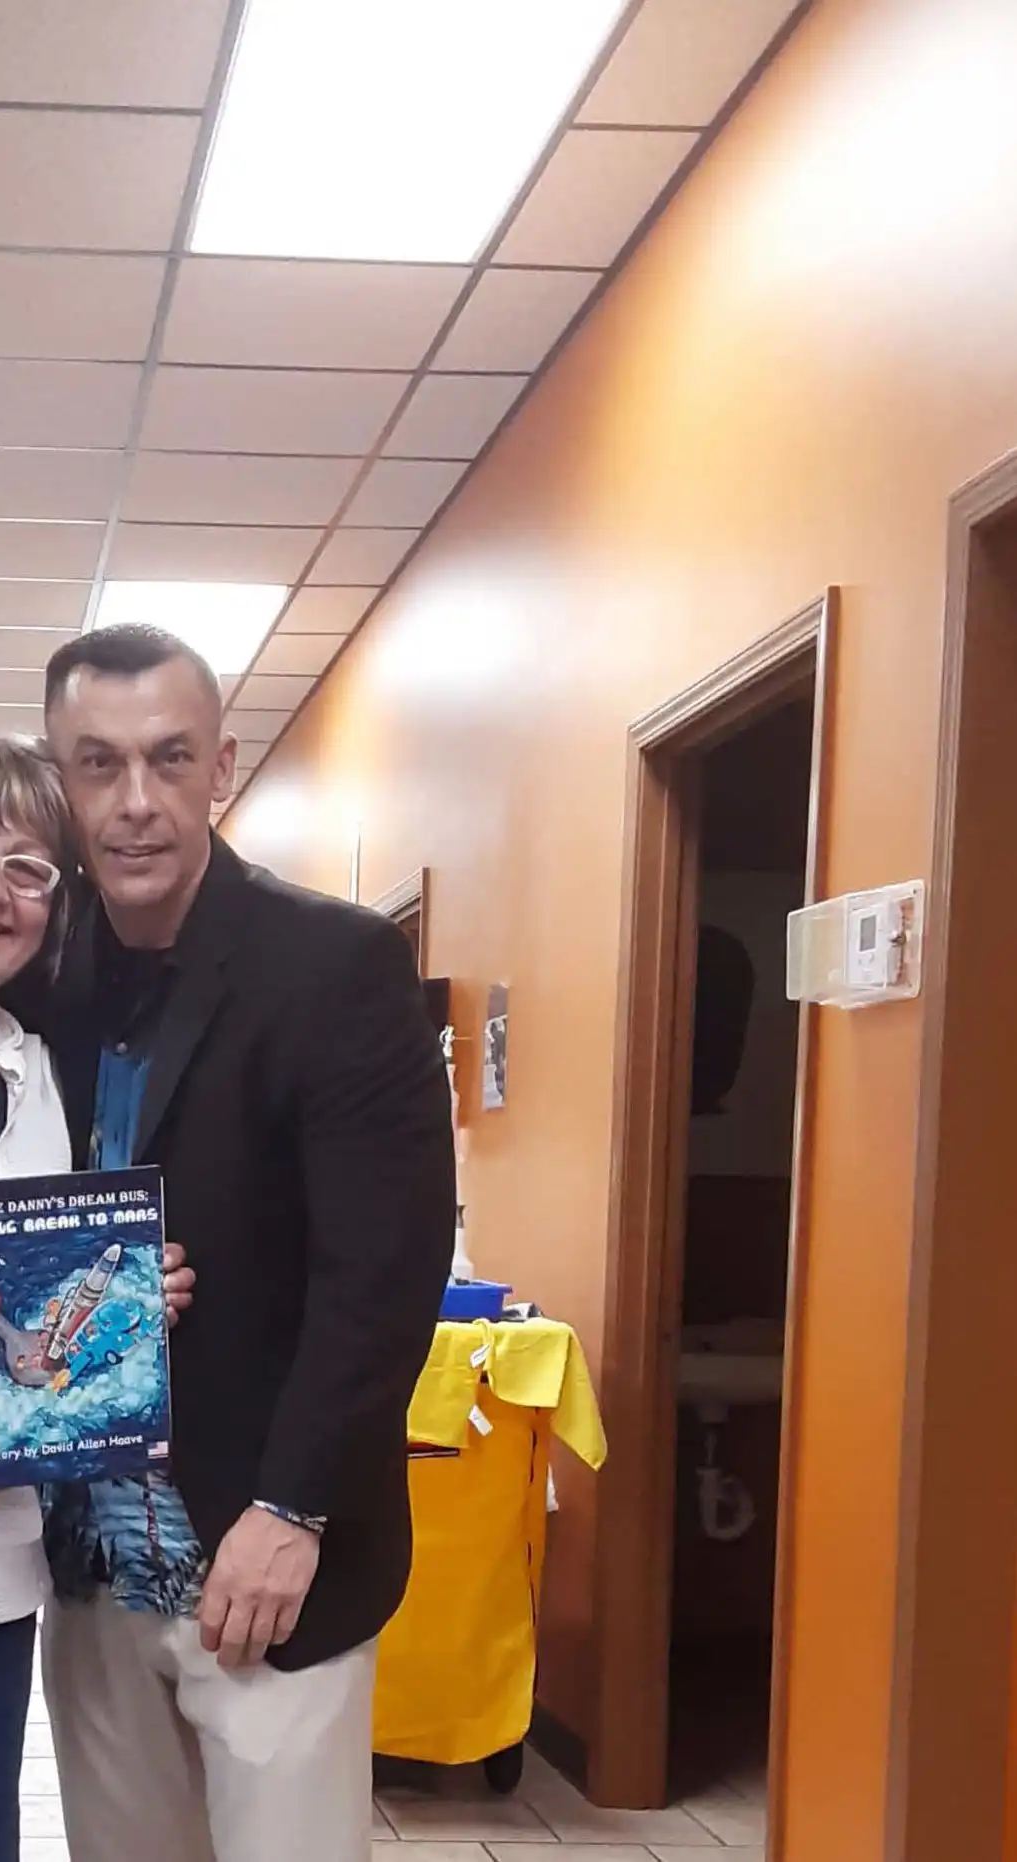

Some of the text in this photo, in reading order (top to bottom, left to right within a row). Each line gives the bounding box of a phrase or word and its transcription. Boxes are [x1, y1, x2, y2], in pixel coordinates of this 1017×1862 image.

[8, 1197, 65, 1213] DANNY'S
[69, 1193, 115, 1207] DREAM
[119, 1190, 149, 1203] BUS:
[23, 1214, 81, 1232] BREAK
[86, 1212, 108, 1226] TO
[113, 1207, 158, 1225] MARS
[24, 1446, 38, 1460] by
[42, 1442, 73, 1455] David
[77, 1437, 107, 1450] Allen
